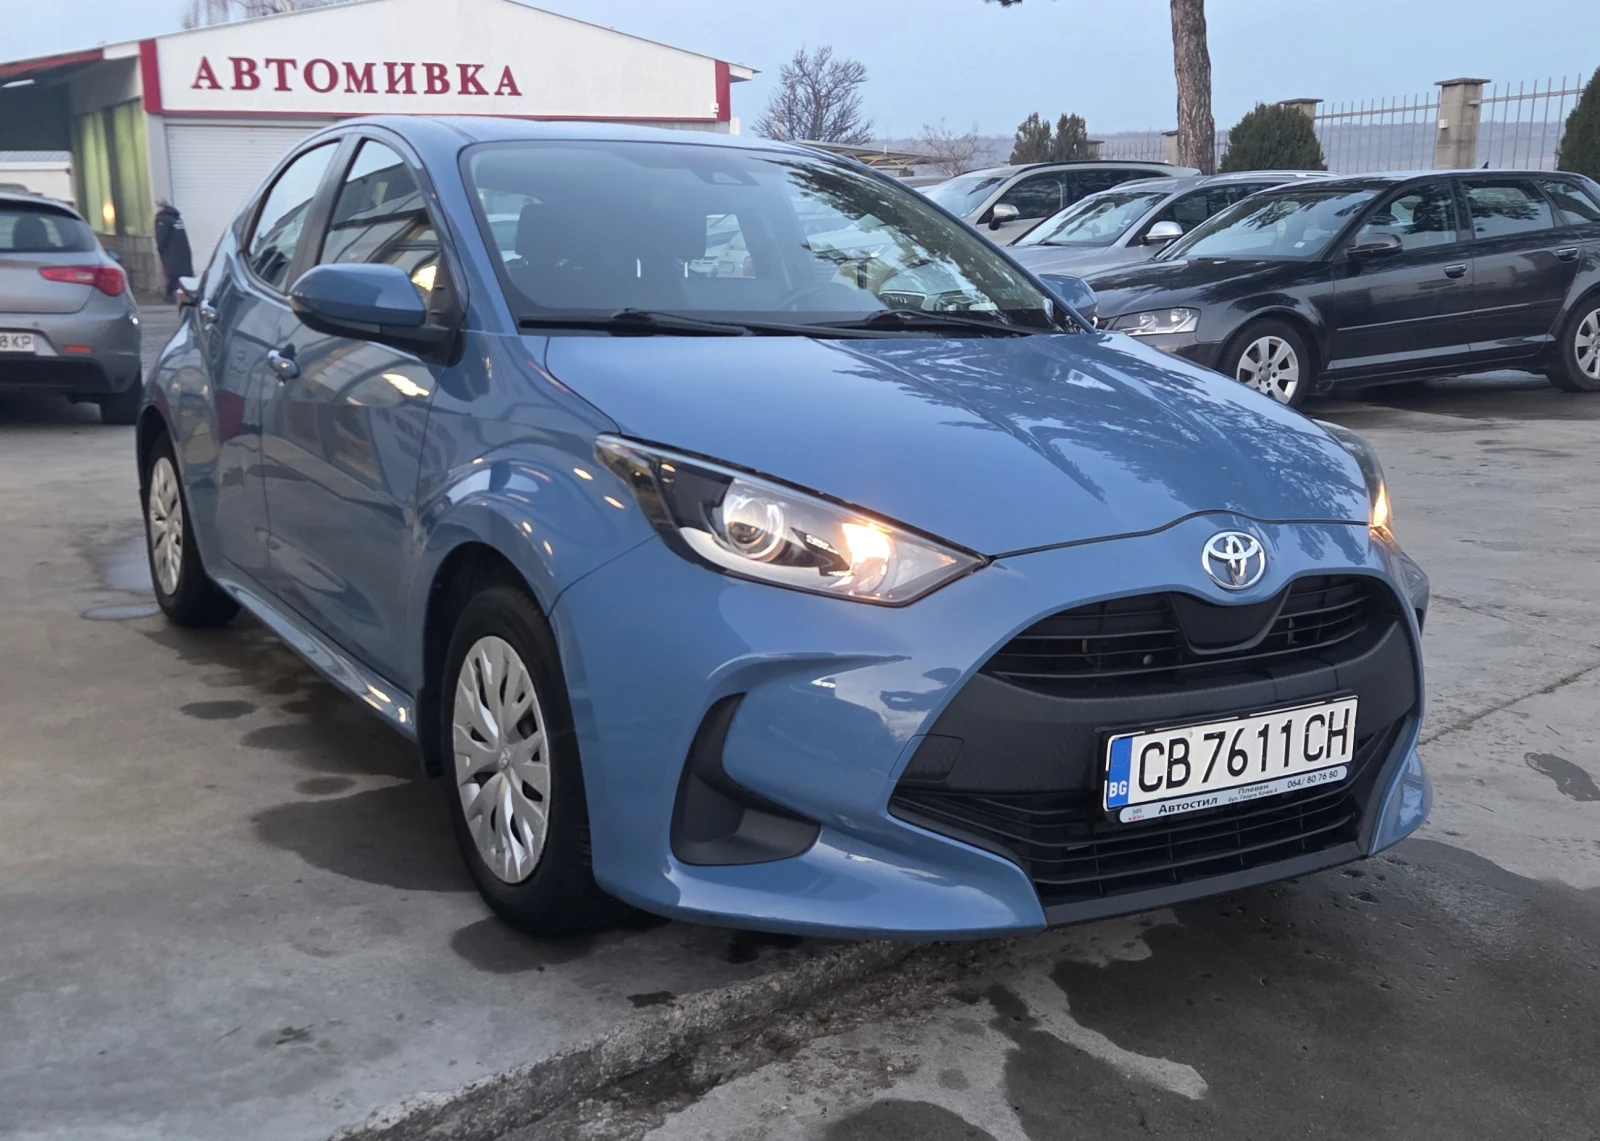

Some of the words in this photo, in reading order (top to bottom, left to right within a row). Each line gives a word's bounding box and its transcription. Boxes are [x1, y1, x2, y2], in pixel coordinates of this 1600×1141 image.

[191, 56, 522, 96] АВТОМИВКА
[1109, 780, 1127, 798] BG
[1158, 797, 1218, 815] Автостил
